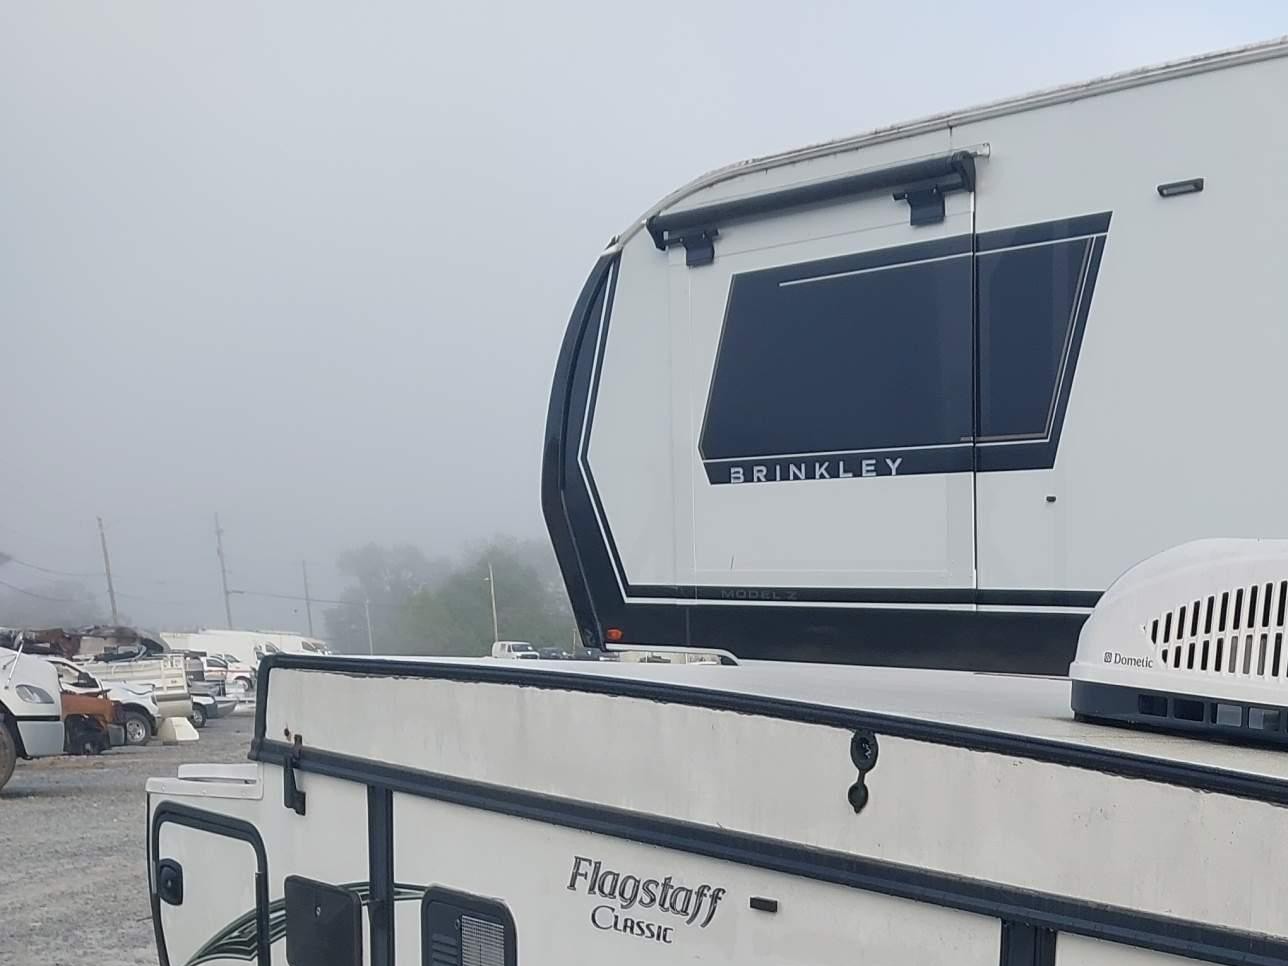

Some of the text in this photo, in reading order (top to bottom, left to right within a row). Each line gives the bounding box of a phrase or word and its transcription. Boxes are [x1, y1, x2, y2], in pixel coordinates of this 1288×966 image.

[730, 457, 902, 484] BRINKLEY
[720, 589, 781, 601] MODEL
[1114, 653, 1154, 669] Dometic
[566, 855, 727, 928] Flagstaff
